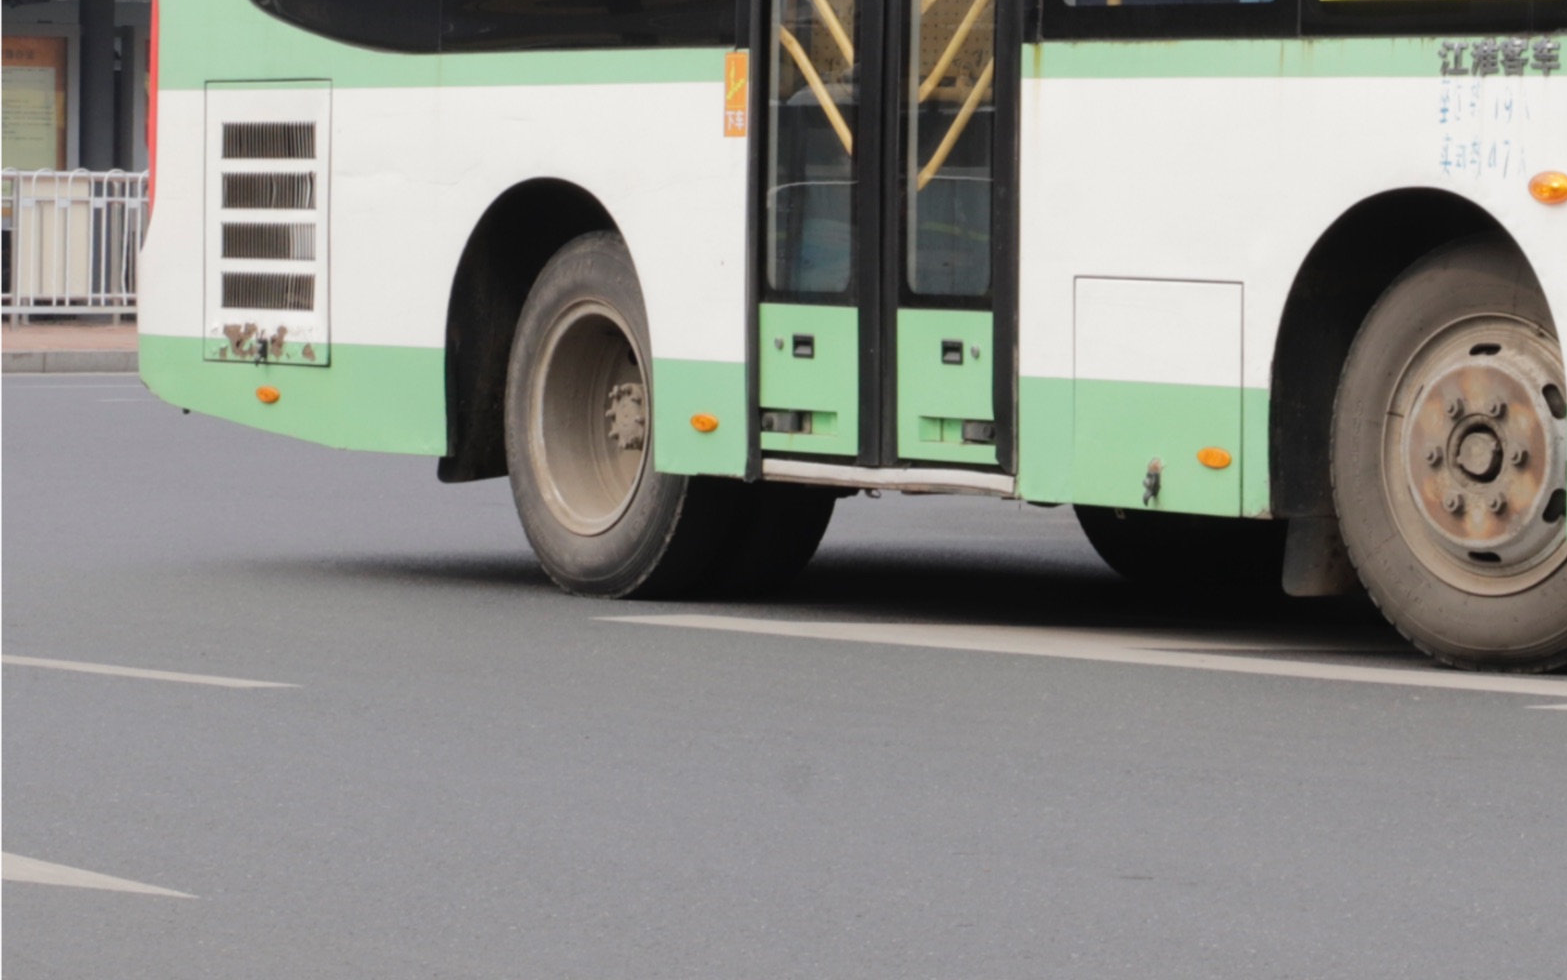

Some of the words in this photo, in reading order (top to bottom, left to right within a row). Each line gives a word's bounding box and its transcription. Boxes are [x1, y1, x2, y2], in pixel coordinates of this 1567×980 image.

[1438, 37, 1560, 77] 江淮客车
[726, 110, 744, 130] 下车
